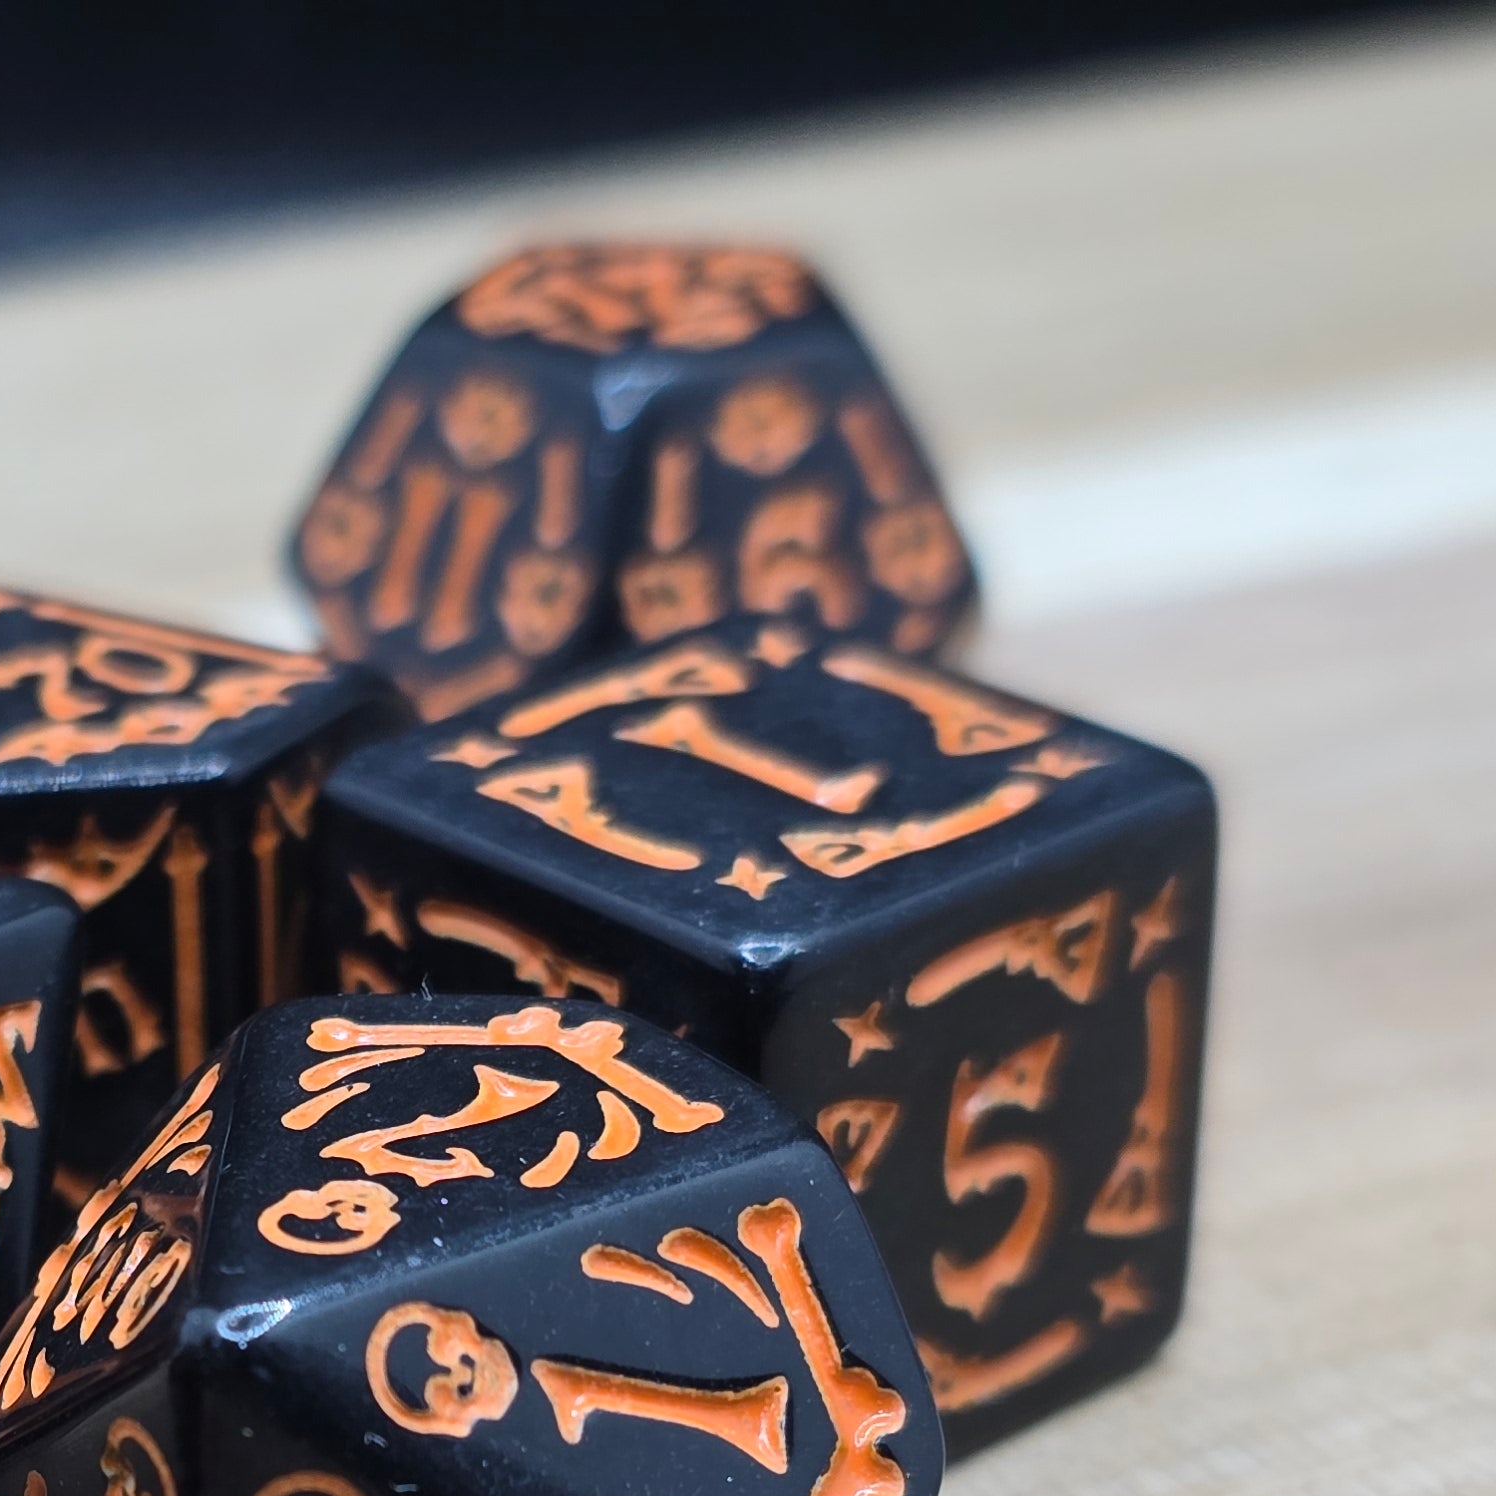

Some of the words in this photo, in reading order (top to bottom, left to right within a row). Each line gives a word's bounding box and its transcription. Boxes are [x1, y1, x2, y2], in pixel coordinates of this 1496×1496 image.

[610, 699, 892, 815] 1
[931, 1032, 1064, 1321] 5
[530, 1357, 788, 1474] 1
